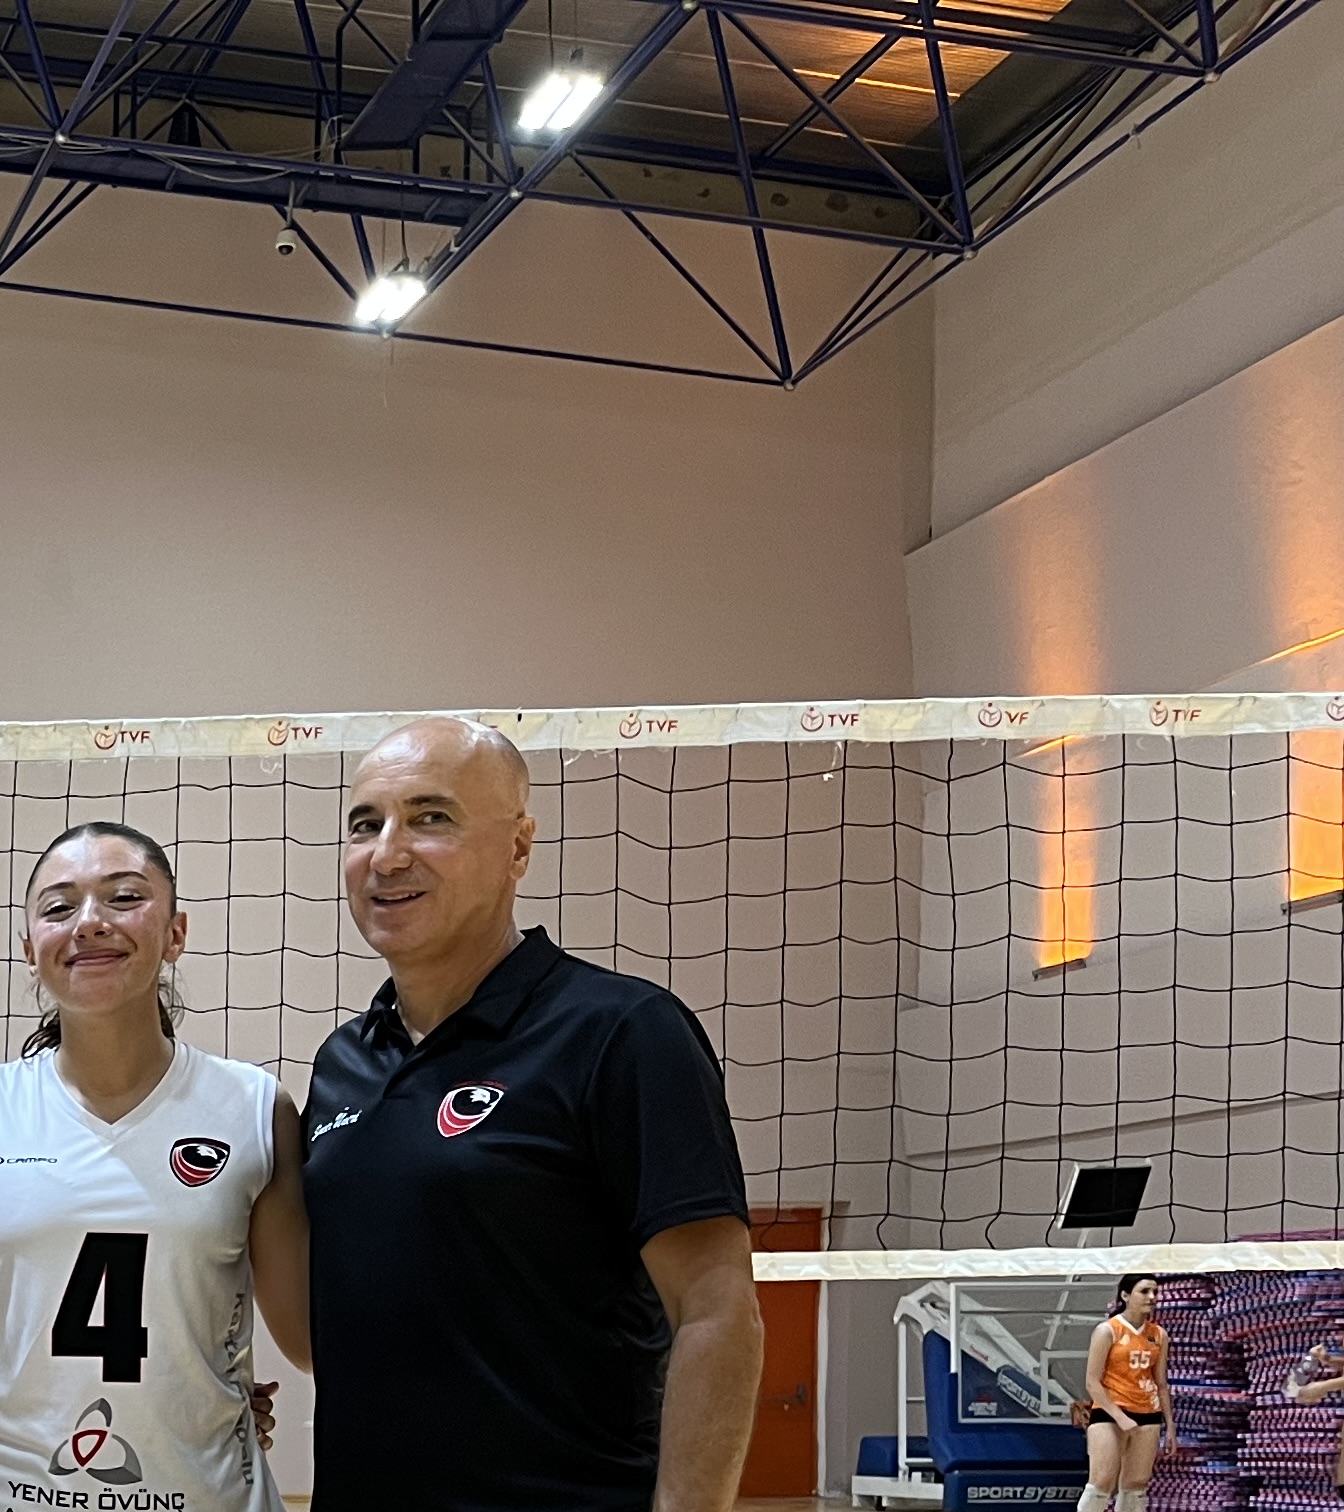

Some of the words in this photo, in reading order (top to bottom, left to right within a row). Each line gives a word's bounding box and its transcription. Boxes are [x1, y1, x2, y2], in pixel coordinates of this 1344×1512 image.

[828, 713, 860, 726] TVF
[1006, 711, 1029, 724] VF
[1172, 709, 1202, 722] TVF
[647, 719, 678, 732] TVF
[118, 730, 150, 744] TVF
[291, 726, 323, 740] TVF
[50, 1231, 149, 1383] 4
[1128, 1350, 1151, 1369] 55
[8, 1480, 89, 1510] YENER
